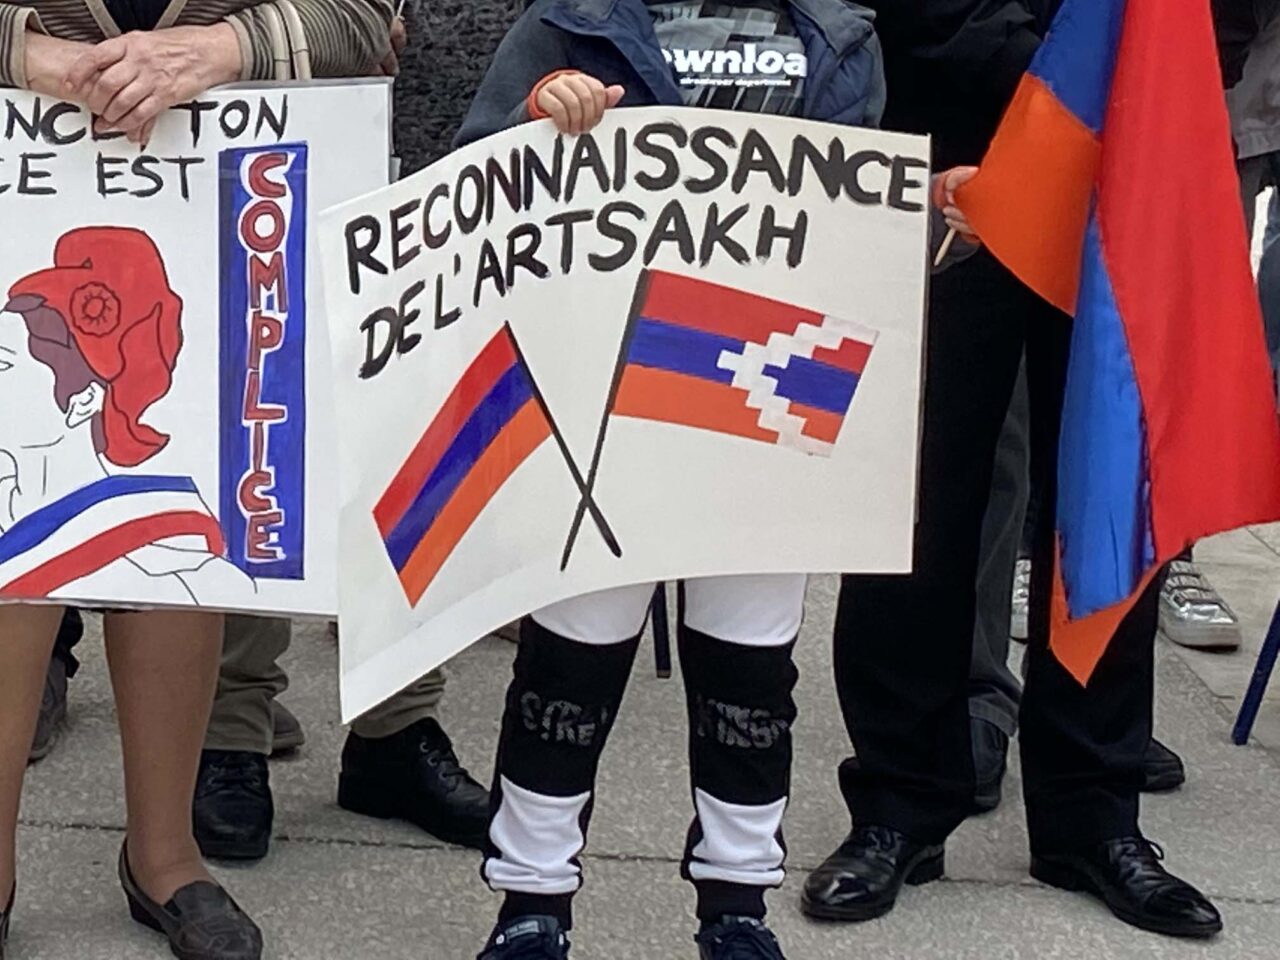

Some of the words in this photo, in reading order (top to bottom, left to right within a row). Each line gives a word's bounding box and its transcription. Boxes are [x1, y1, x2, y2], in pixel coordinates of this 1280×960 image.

[96, 151, 206, 202] EST
[170, 94, 290, 149] TON
[344, 120, 930, 292] RECONNAISSANCE
[240, 151, 290, 560] COMPLICE
[358, 280, 426, 379] DE
[433, 200, 808, 330] L'ARTSAKH
